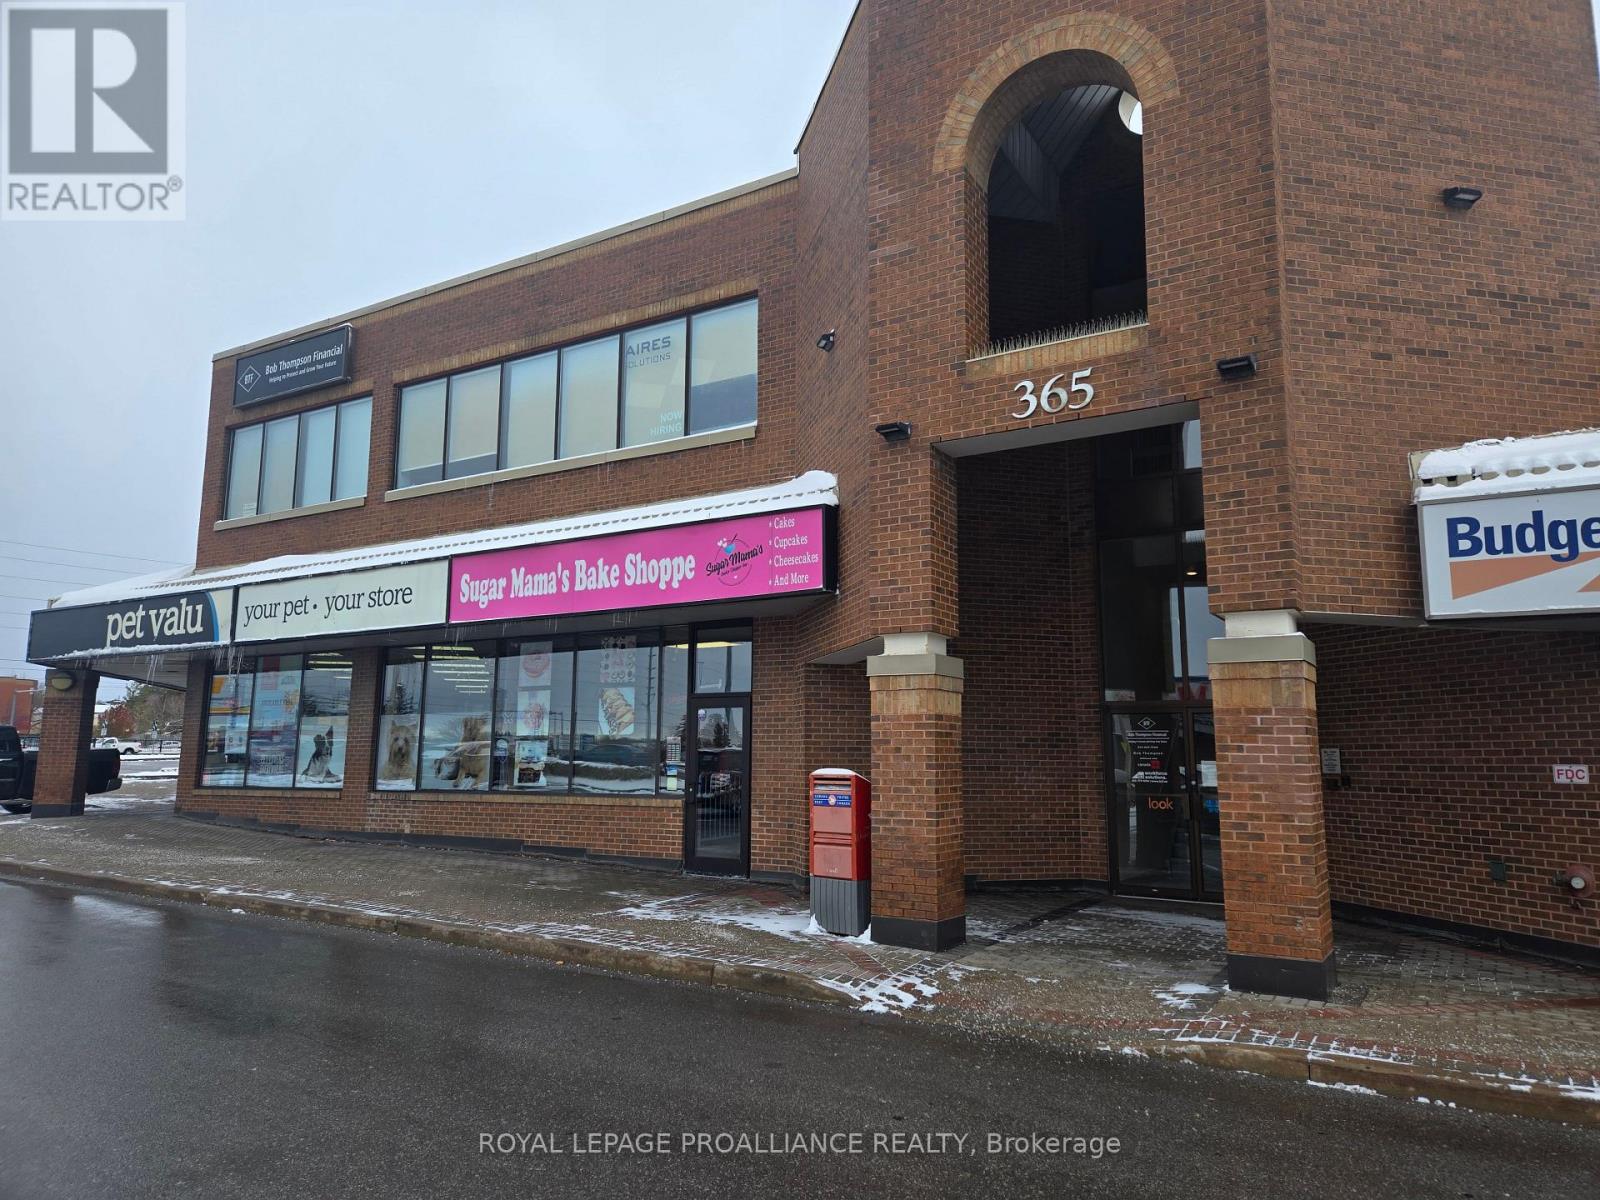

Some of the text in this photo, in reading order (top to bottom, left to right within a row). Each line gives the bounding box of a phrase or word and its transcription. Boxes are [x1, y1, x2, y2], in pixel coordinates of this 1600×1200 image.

[626, 336, 671, 356] AIRES
[265, 344, 343, 375] Bob Thompson Financial
[1012, 367, 1094, 419] 365
[660, 409, 683, 424] NOW
[650, 422, 683, 436] HIRING
[773, 517, 795, 530] Cakes
[773, 534, 808, 549] Cupcakes
[706, 558, 729, 576] Sugar
[729, 544, 763, 566] Mama's
[773, 552, 819, 567] Cheesecakes
[459, 552, 696, 609] Sugar Mama's Bake Shoppe
[773, 572, 809, 587] And More
[243, 586, 413, 627] your pet your store
[106, 598, 204, 647] pet valu
[1556, 769, 1586, 780] FDC
[1148, 797, 1174, 810] look
